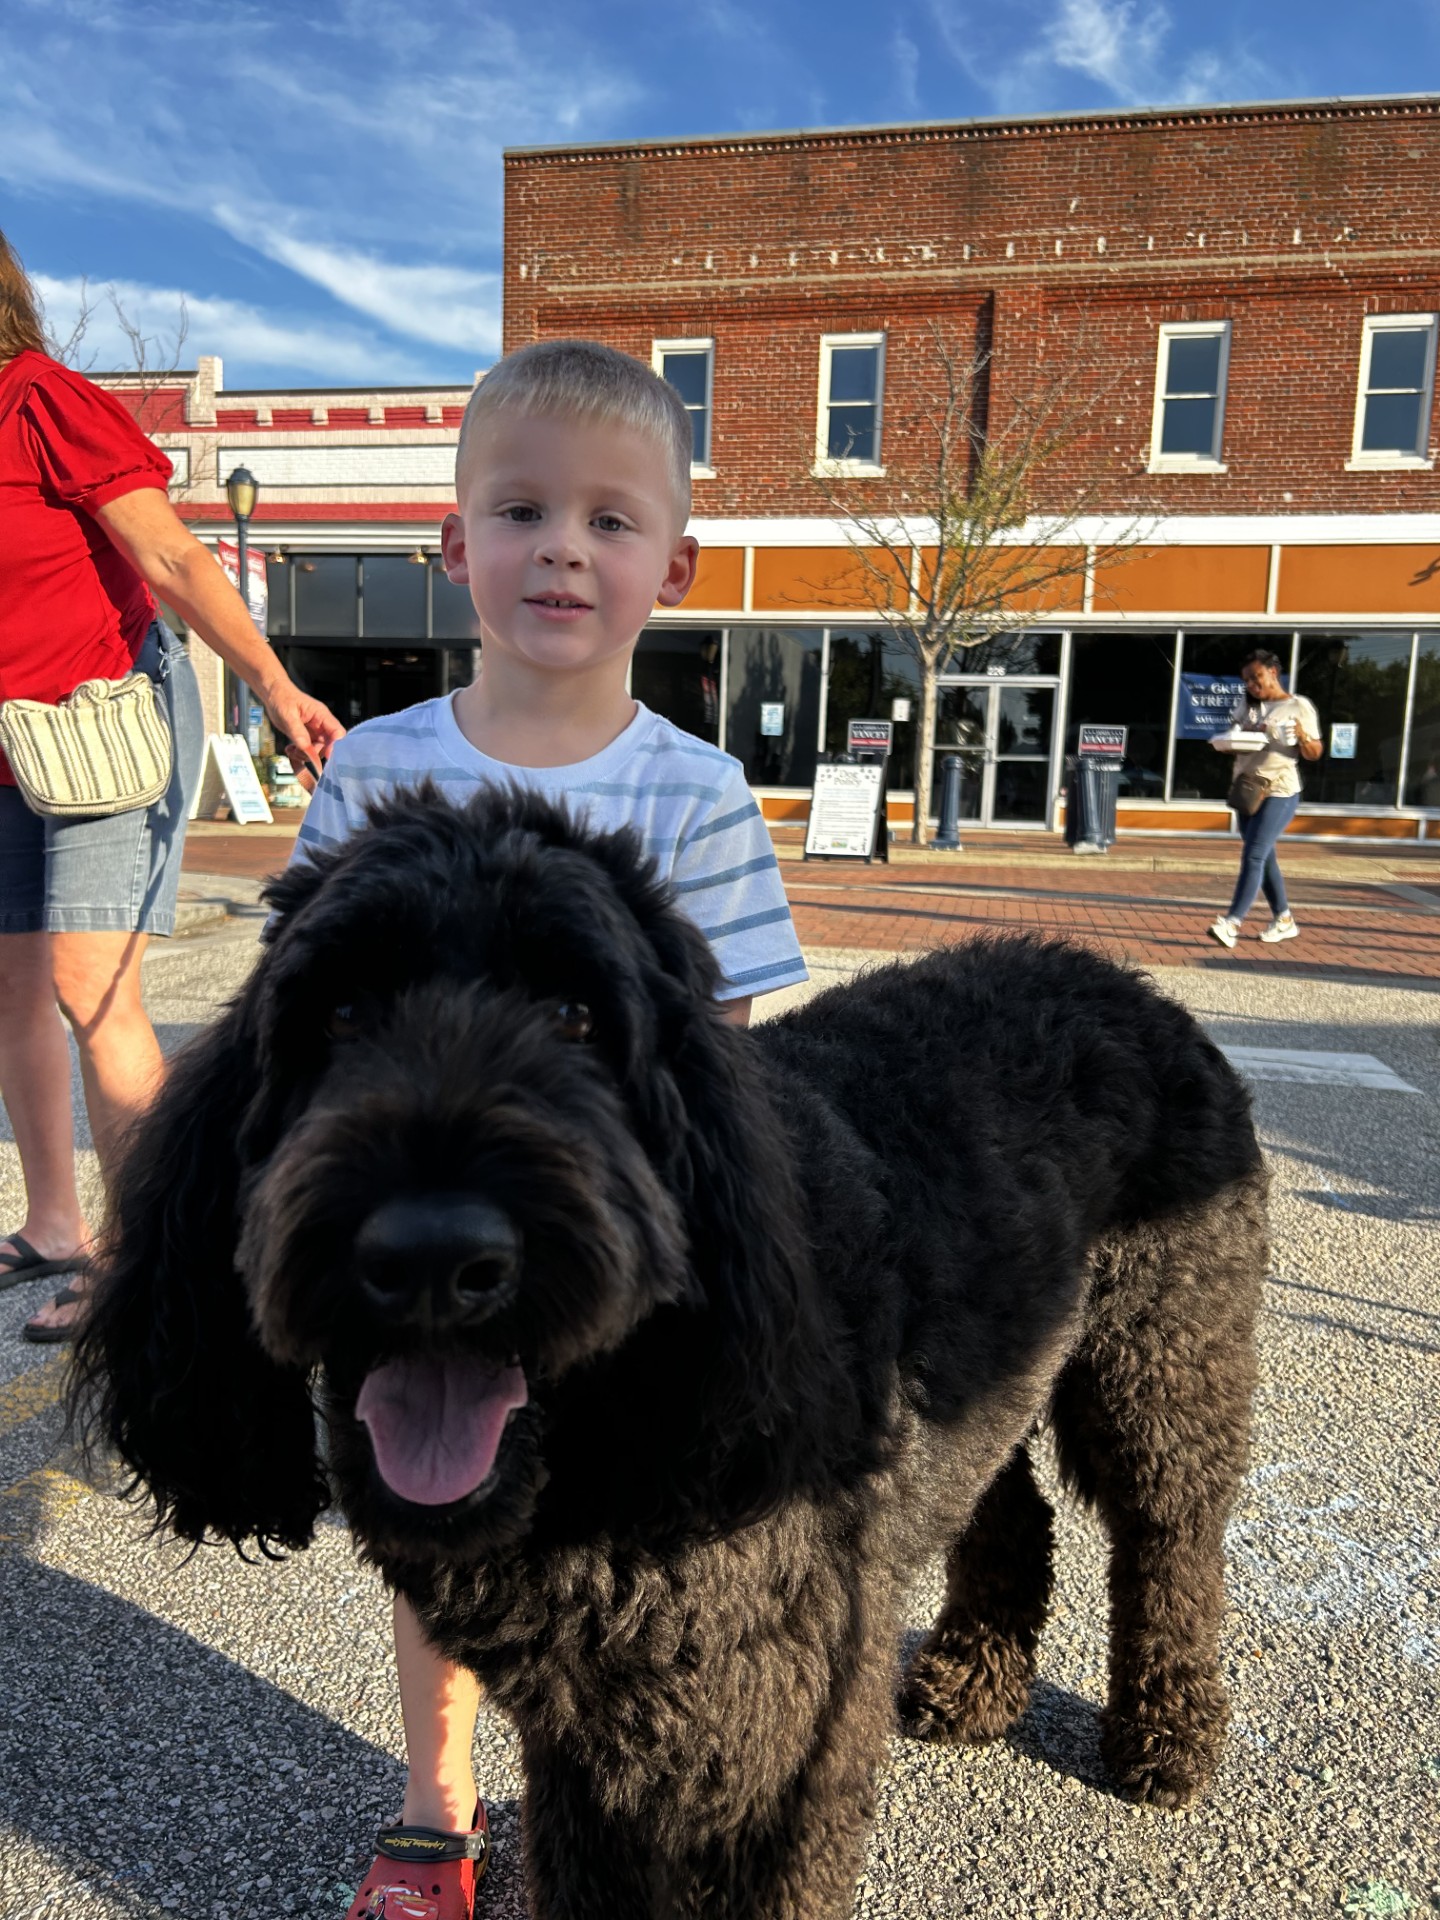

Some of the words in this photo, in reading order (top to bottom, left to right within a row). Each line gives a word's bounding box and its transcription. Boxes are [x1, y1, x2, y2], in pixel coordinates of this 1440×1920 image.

[1210, 682, 1247, 694] GREE
[1191, 695, 1241, 707] STREET
[852, 730, 888, 739] YANCEY
[1084, 735, 1122, 744] YANCEY
